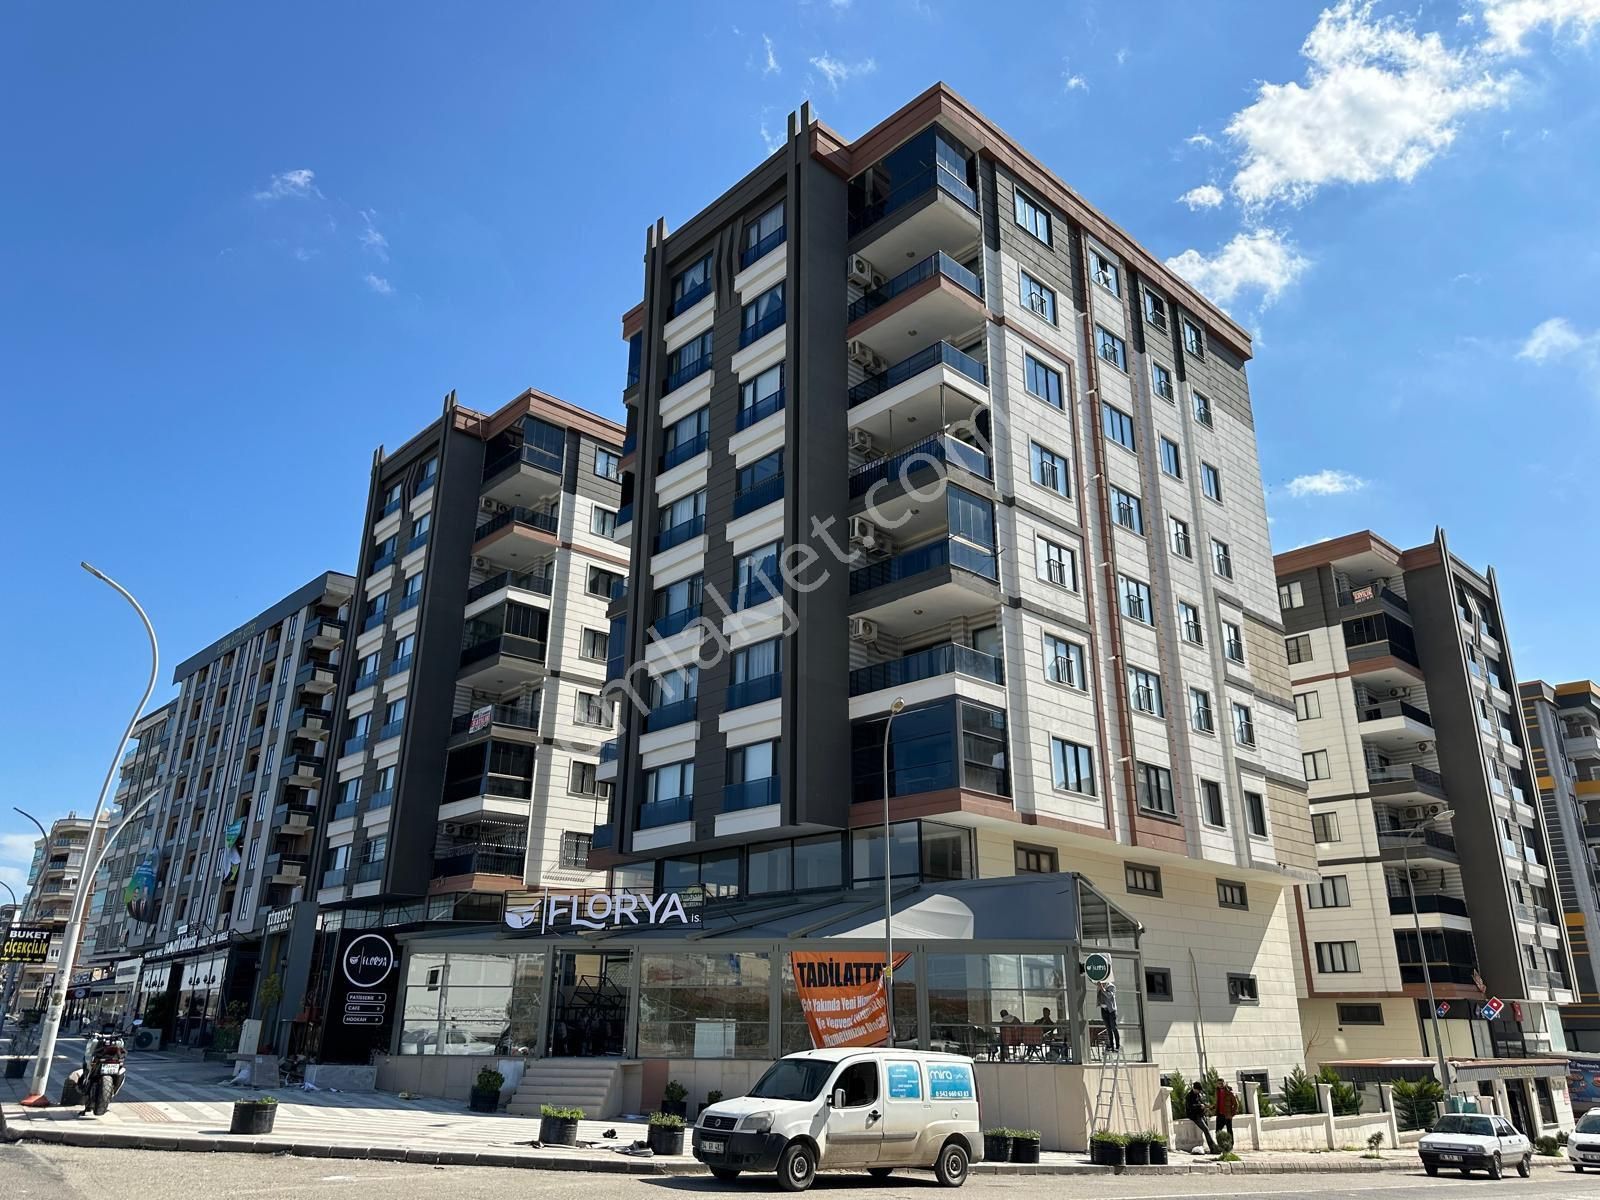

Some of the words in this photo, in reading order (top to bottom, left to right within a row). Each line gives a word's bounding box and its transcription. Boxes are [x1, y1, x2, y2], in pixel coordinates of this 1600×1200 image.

[548, 893, 688, 929] FLORYA
[9, 930, 50, 939] BUKET
[4, 938, 48, 957] ÇİÇEKÇİLİK
[812, 998, 840, 1013] Yakında
[840, 996, 857, 1009] Yeni
[930, 1070, 953, 1080] mira
